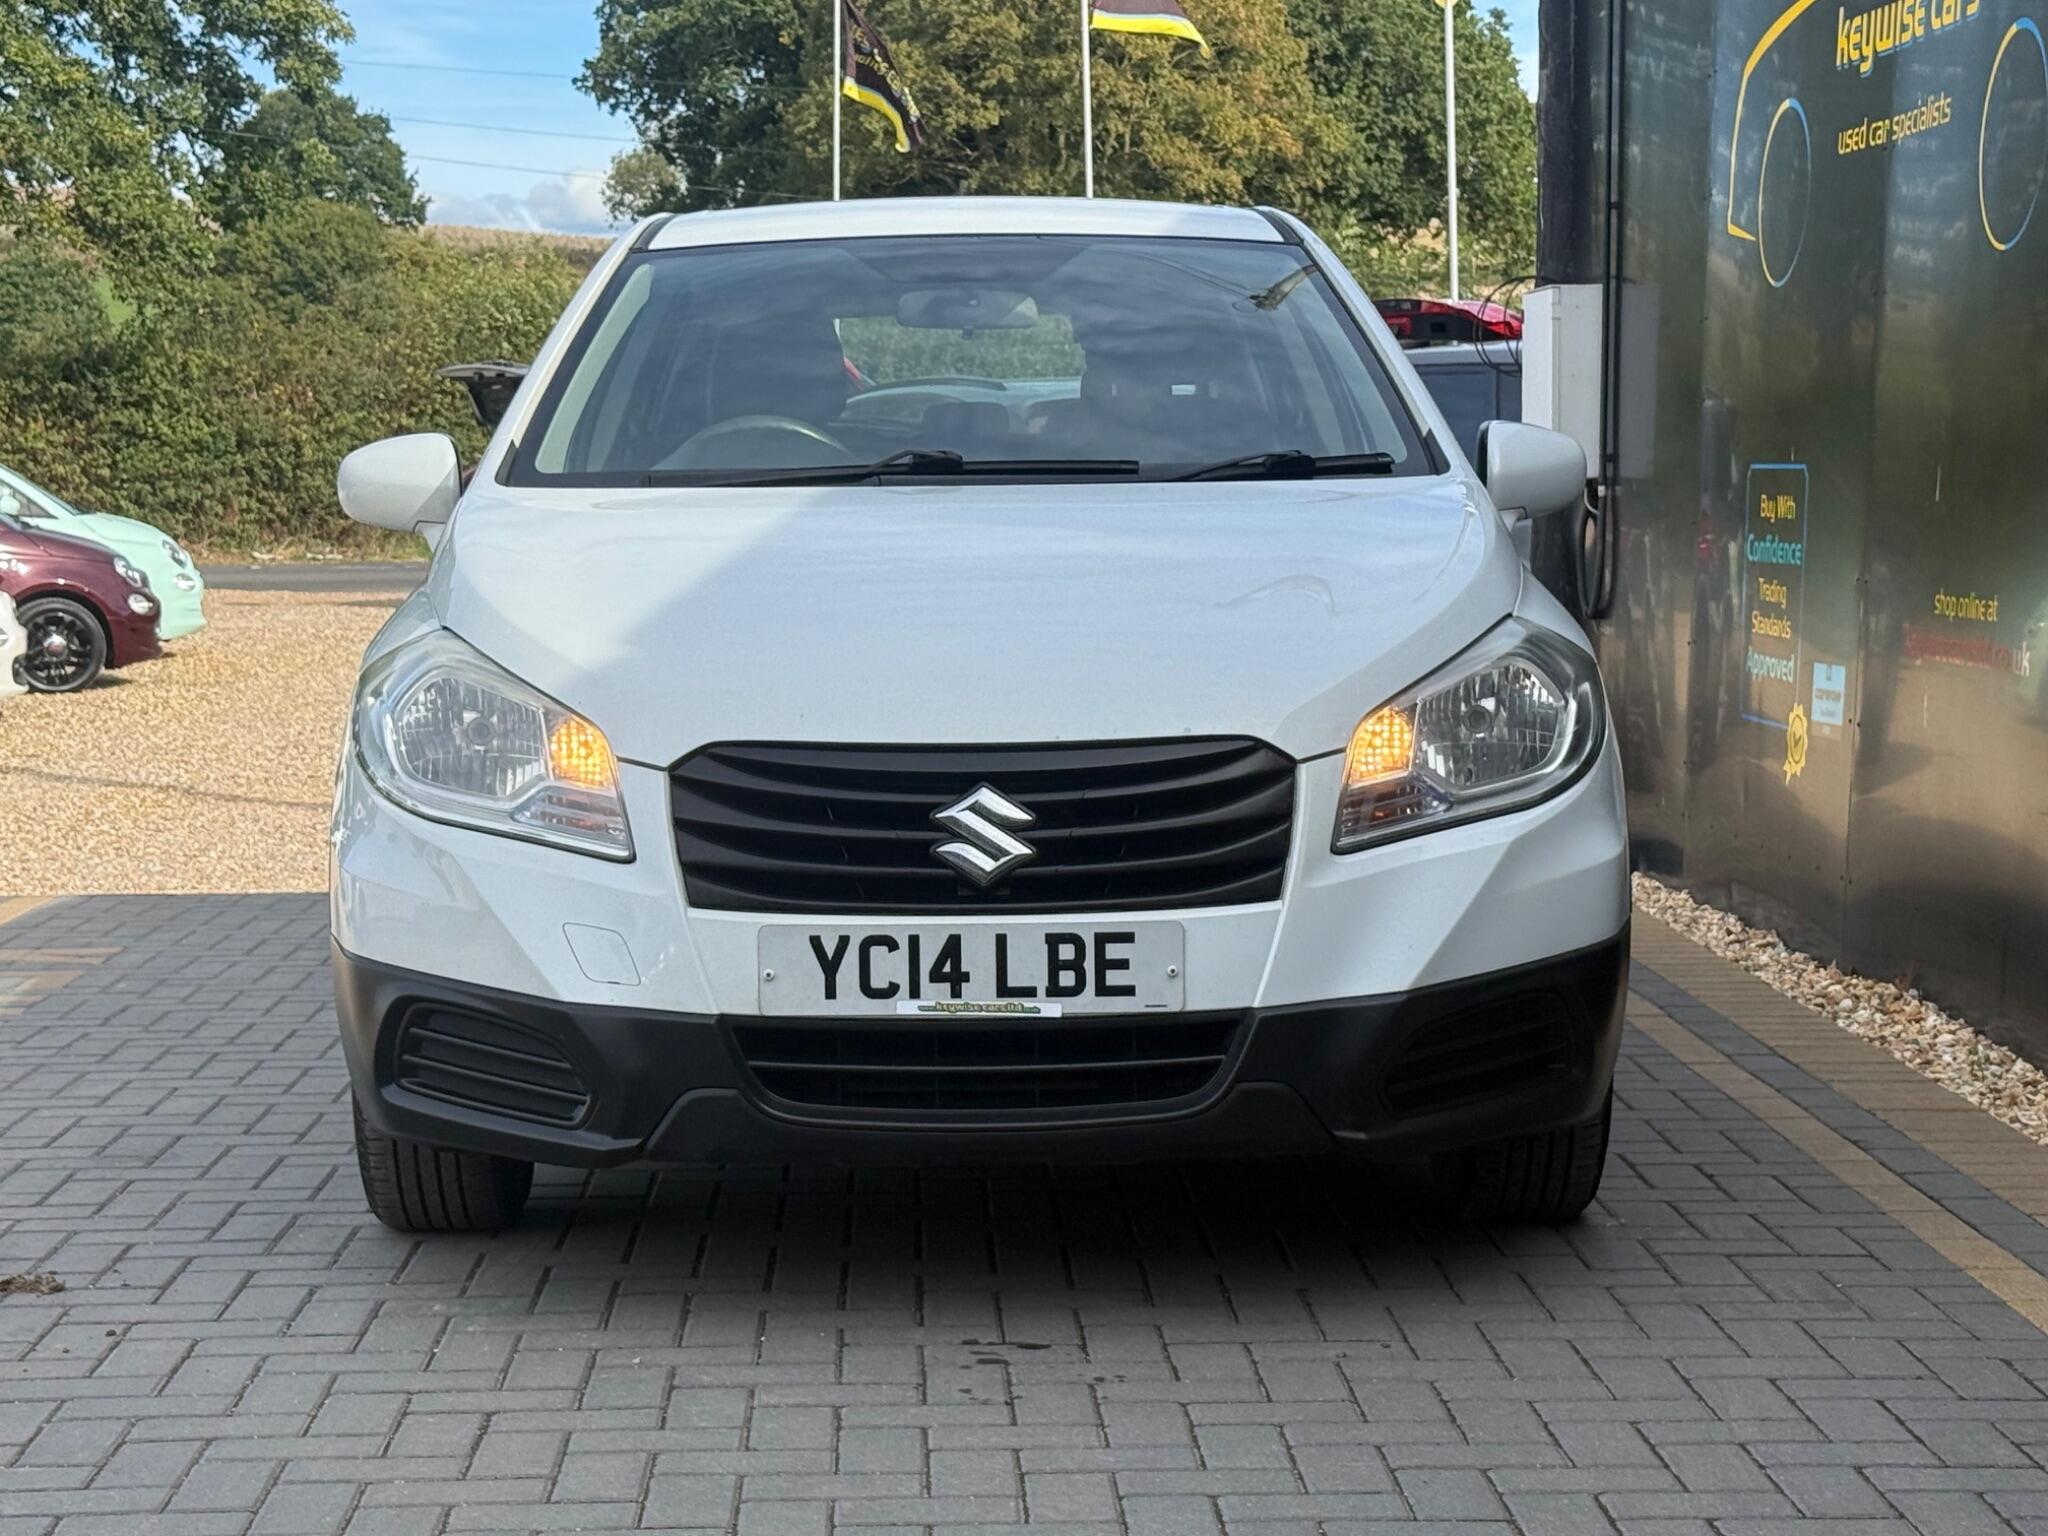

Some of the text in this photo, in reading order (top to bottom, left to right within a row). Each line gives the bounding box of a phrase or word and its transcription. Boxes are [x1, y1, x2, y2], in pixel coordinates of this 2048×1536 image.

[1836, 0, 1926, 76] keywise
[1838, 91, 1952, 155] used car specialists
[1760, 494, 1796, 523] Buy With
[1747, 533, 1802, 565] Confidence
[1758, 577, 1787, 609] Trading
[1934, 588, 1998, 622] shop online at
[1751, 610, 1792, 639] Standards
[1746, 645, 1794, 683] Approved
[808, 931, 1136, 1000] YC14 LBE
